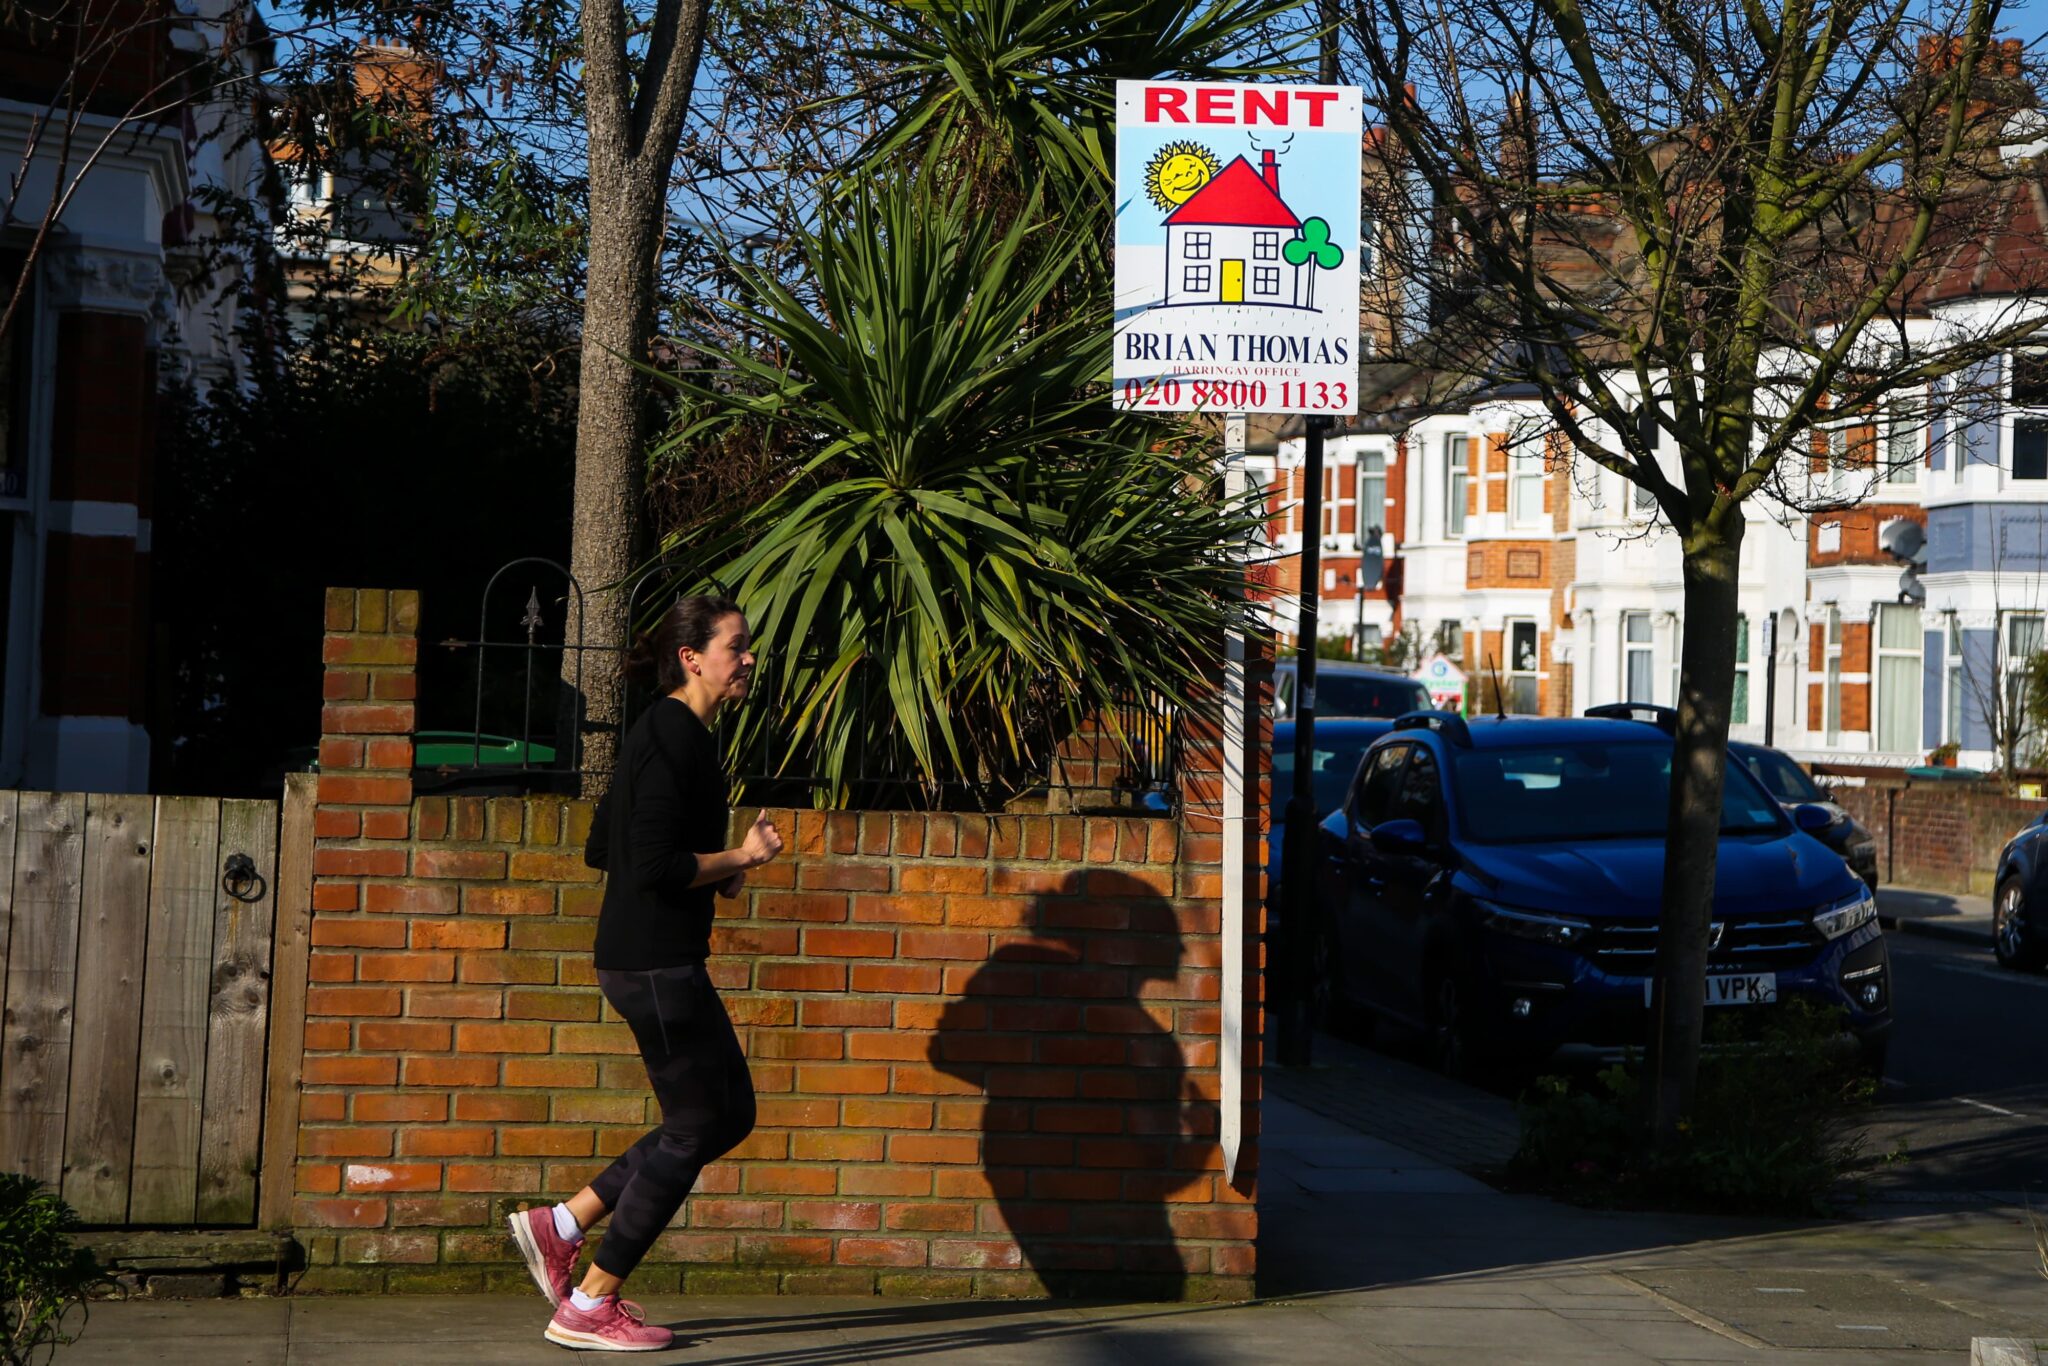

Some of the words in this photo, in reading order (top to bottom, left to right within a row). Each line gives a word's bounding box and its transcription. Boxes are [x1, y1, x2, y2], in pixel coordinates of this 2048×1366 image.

[1144, 87, 1339, 127] RENT
[1125, 332, 1217, 361] BRIAN
[1227, 334, 1348, 364] THOMAS
[1173, 365, 1250, 376] HARRINGAY
[1254, 367, 1300, 377] OFFICE
[1124, 377, 1181, 406] 020
[1192, 379, 1267, 408] 8800
[1280, 381, 1348, 410] 1133
[1717, 976, 1761, 1001] VPK
